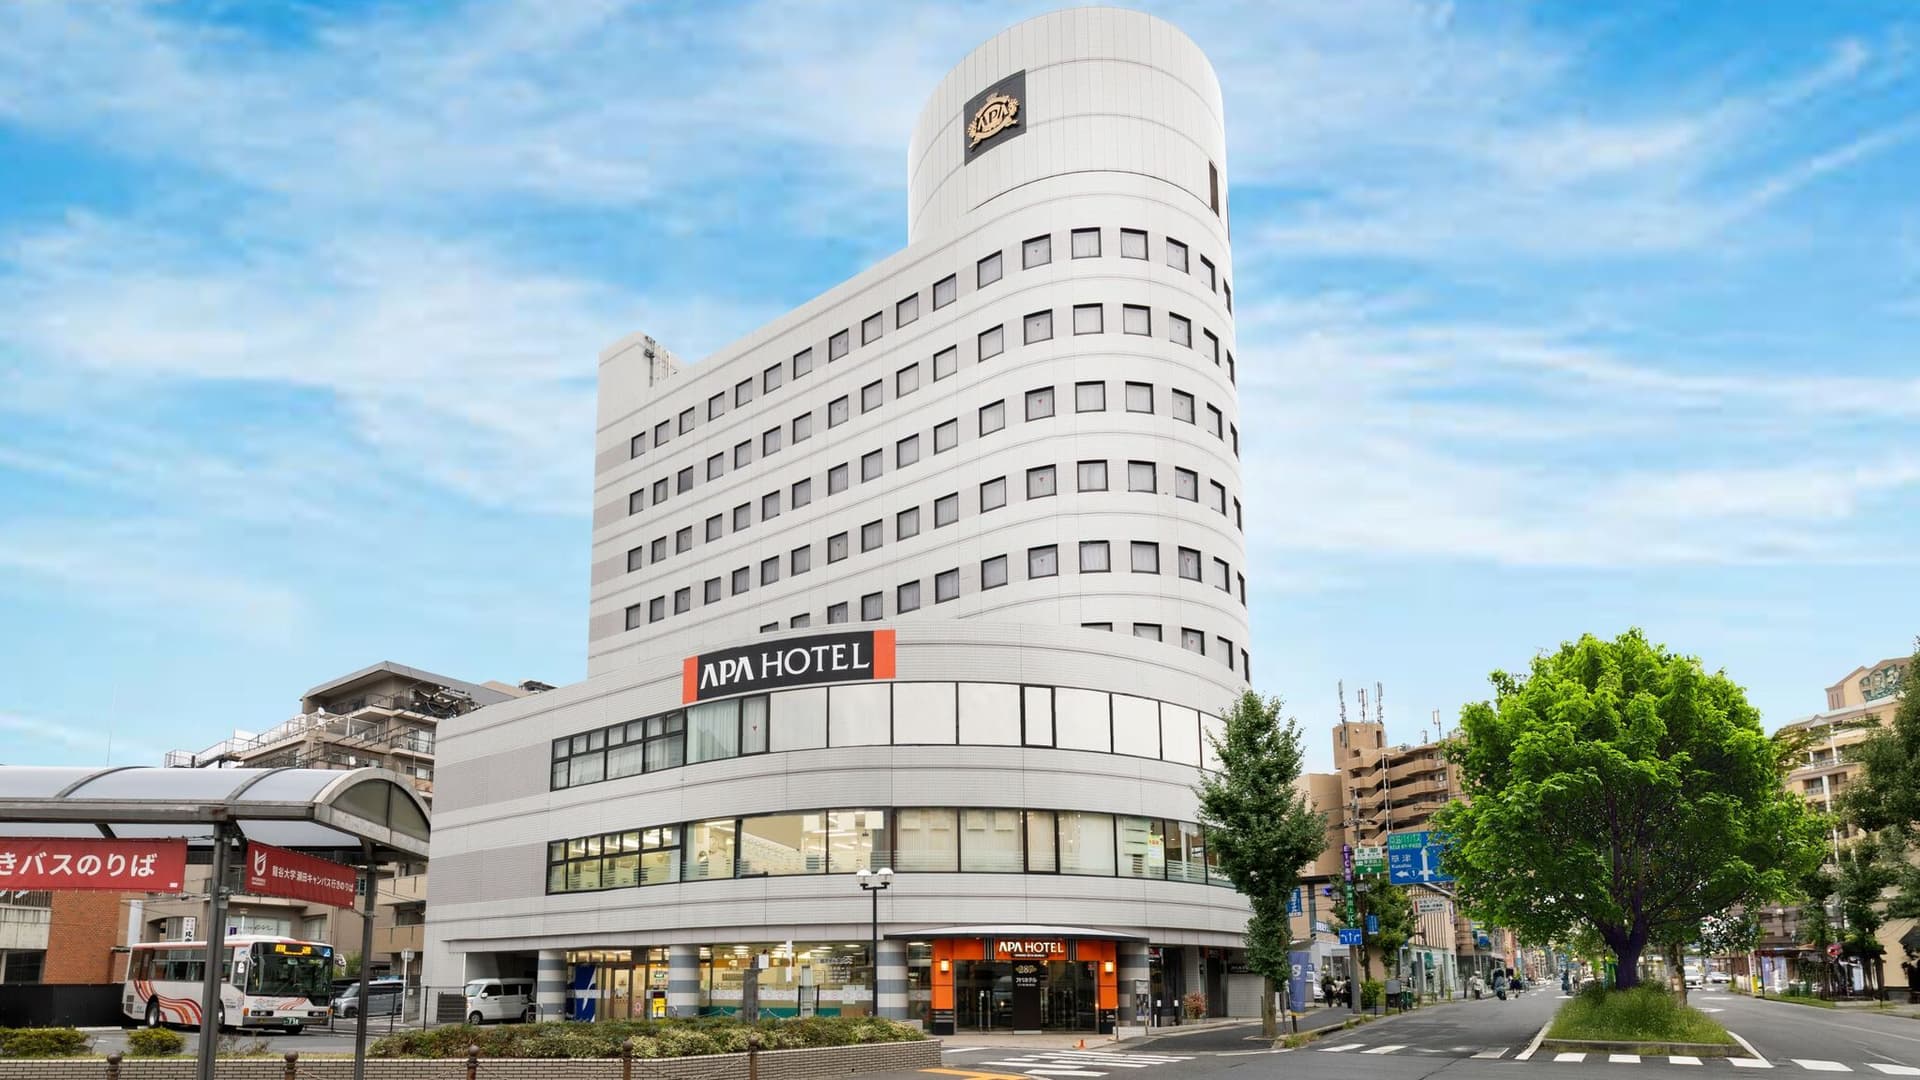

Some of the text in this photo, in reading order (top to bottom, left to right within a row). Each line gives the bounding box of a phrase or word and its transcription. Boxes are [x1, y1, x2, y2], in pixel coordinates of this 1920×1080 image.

[700, 642, 870, 690] APA HOTEL
[0, 852, 158, 877] きバスのりば
[999, 941, 1065, 953] APA HOTEL
